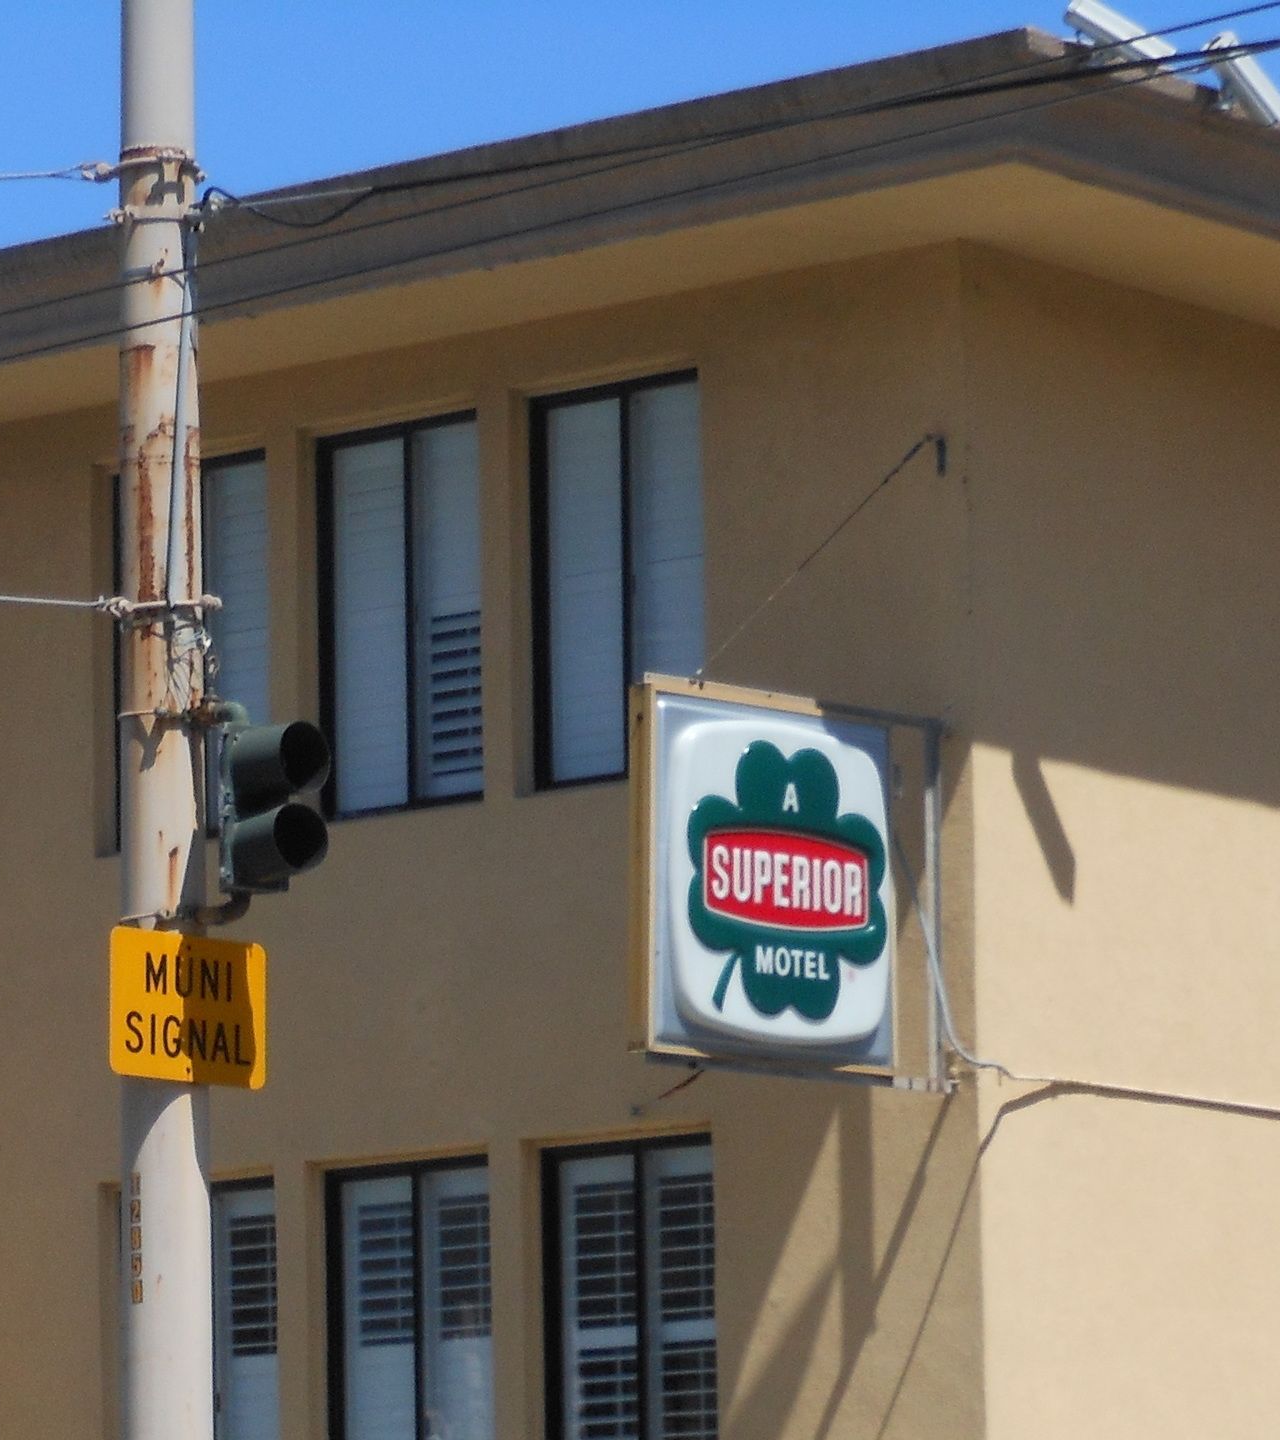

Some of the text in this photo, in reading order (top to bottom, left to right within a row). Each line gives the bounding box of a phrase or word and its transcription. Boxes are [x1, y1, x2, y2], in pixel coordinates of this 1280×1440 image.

[781, 783, 800, 813] A
[711, 845, 865, 917] SUPERIOR
[145, 951, 233, 1003] MUNI
[755, 944, 831, 981] MOTEL
[125, 1010, 252, 1067] SIGNAL
